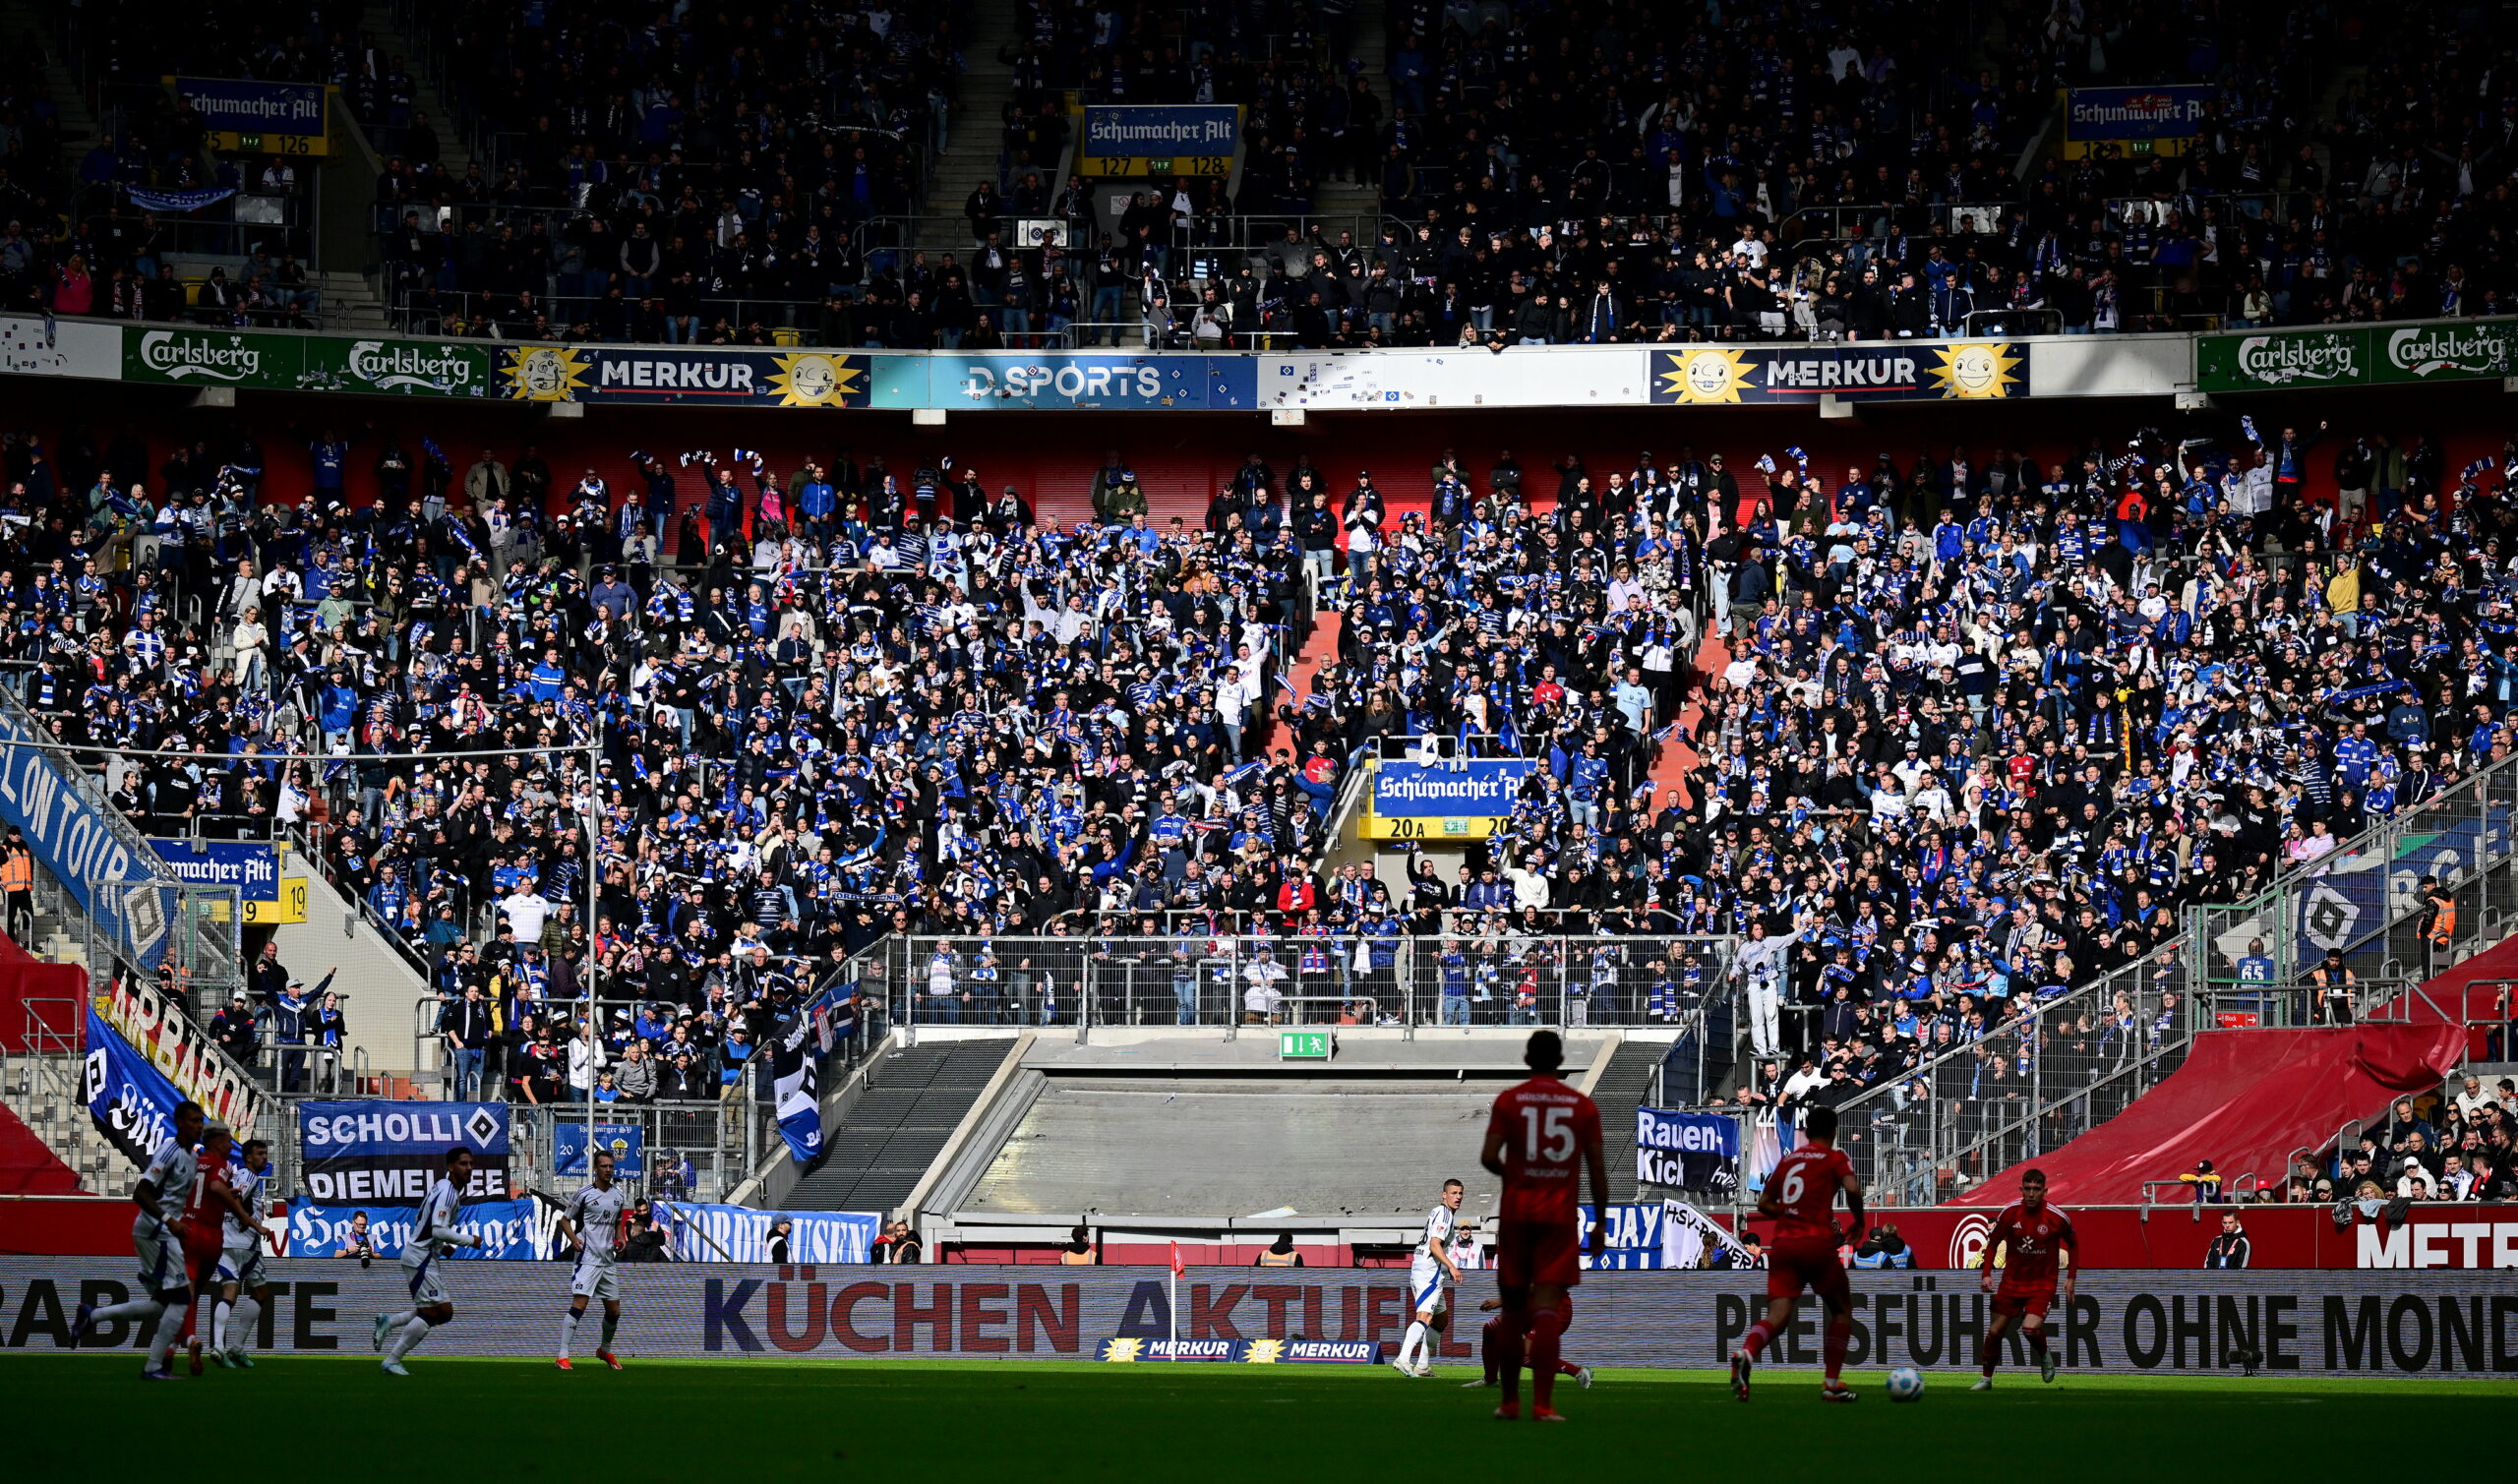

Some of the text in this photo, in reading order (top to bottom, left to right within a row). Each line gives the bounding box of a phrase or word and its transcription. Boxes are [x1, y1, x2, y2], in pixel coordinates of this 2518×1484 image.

[292, 98, 318, 120] Alt
[278, 136, 309, 154] 126
[1092, 120, 1231, 144] Schumacher Alt
[1101, 157, 1131, 175] 127
[1191, 157, 1221, 175] 128
[141, 330, 260, 378] Carlsberg
[349, 341, 470, 386] Carlsberg
[2238, 335, 2352, 383] Carlsberg
[2388, 327, 2503, 377] Carlsberg
[601, 360, 753, 389] MERKUR
[1768, 357, 1916, 387] MERKUR
[1380, 776, 1499, 801] Schumacher
[22, 755, 58, 843] ON
[52, 790, 129, 917] TOUR
[1390, 818, 1425, 838] 20 A
[244, 858, 273, 884] Alt
[290, 885, 306, 917] 19
[307, 1112, 462, 1146] SCHOLLI
[578, 1125, 617, 1135] Haburger
[1520, 1105, 1576, 1163] 15
[1638, 1112, 1723, 1152] Rauen-
[1755, 1106, 1778, 1140] 44
[559, 1144, 573, 1157] 20
[308, 1168, 506, 1201] DIEMELEE
[1782, 1160, 1807, 1206] 6
[678, 1209, 869, 1264] ORDHUSEN
[702, 1265, 1080, 1353] KÜCHEN
[2123, 1292, 2301, 1370] OHNE
[1148, 1339, 1229, 1356] MERKUR
[1289, 1340, 1371, 1359] MERKUR
